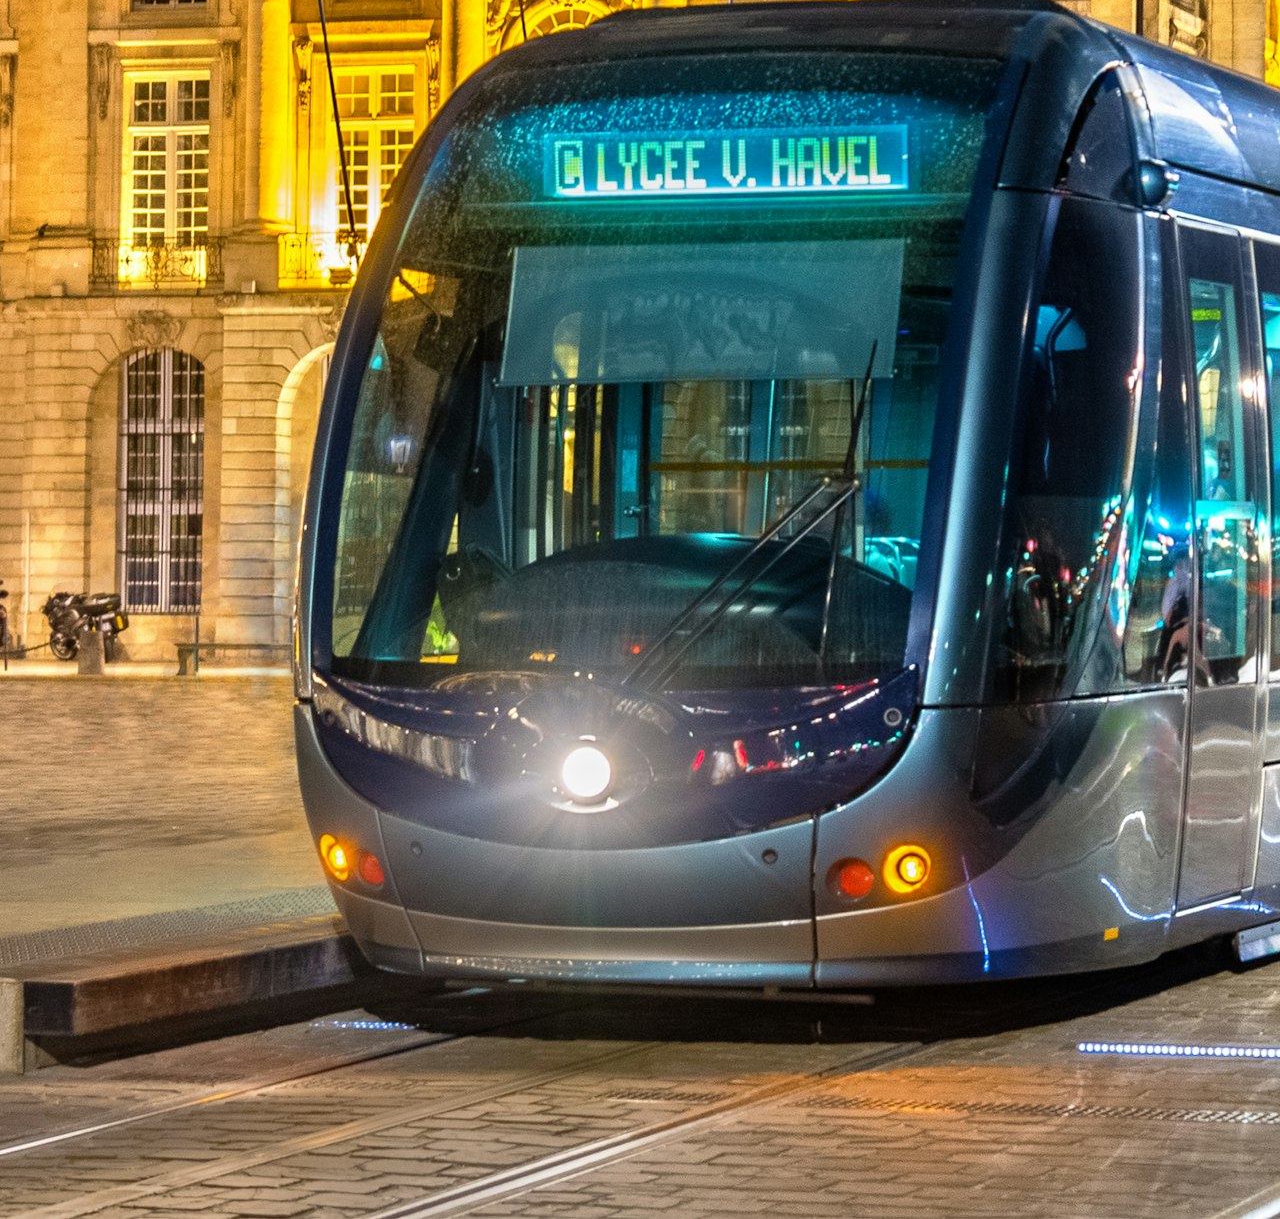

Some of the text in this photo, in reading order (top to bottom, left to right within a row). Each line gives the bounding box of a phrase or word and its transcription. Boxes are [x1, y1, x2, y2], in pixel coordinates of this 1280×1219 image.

[597, 140, 707, 191] LYCEE
[722, 138, 756, 188] V.
[772, 135, 891, 187] HAVEL
